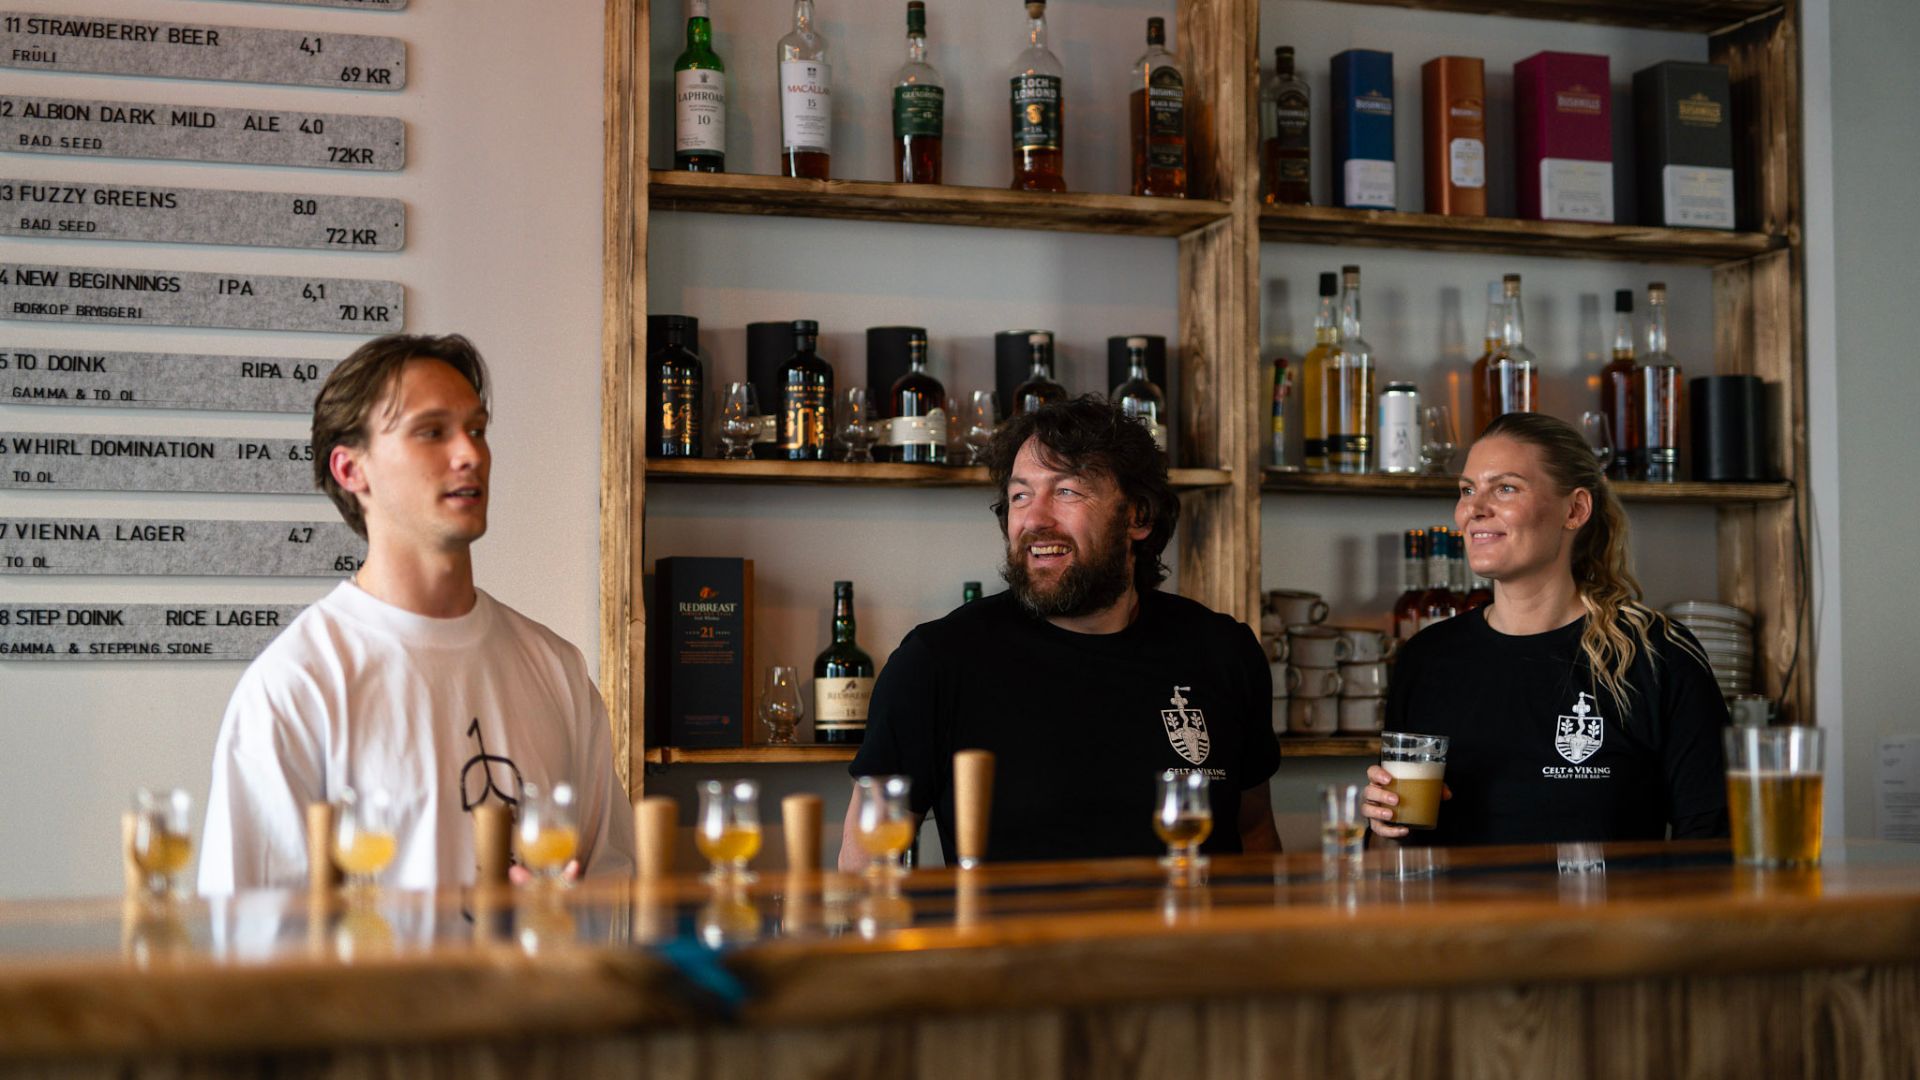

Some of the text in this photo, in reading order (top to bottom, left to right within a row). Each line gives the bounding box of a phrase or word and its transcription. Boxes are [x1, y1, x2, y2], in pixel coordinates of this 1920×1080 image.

[6, 17, 321, 56] 11 STRAWBERRY BEER 4,1
[341, 67, 390, 84] 69 KR
[1022, 78, 1049, 88] LOCH
[1014, 88, 1057, 99] LOMOND
[807, 99, 816, 107] 15
[23, 103, 89, 121] ALBION
[101, 107, 155, 124] DARK
[172, 111, 215, 128] MILD
[244, 116, 279, 132] ALE
[697, 115, 711, 125] 10
[20, 135, 102, 149] BAD SEED
[20, 186, 86, 203] FUZZY
[95, 190, 176, 208] GREENS
[294, 200, 316, 215] 8.0
[21, 219, 95, 232] BAD SEED
[327, 228, 376, 244] 72 KR
[16, 270, 58, 286] NEW
[69, 272, 180, 292] BEGINNINGS
[219, 280, 253, 295] IPA
[303, 284, 324, 302] 6,1
[14, 303, 141, 318] BORKOP BRYGGERI
[340, 305, 388, 321] 70 KR
[15, 354, 36, 370] TO
[48, 355, 105, 372] DOINK
[242, 363, 282, 378] RIPA
[13, 387, 67, 399] GAMMA
[76, 389, 85, 399] &
[94, 390, 110, 400] TO
[13, 439, 81, 455] WHIRL
[91, 440, 213, 458] DOMINATION
[239, 444, 271, 459] IPA
[14, 471, 30, 482] TO
[16, 524, 100, 540] VIENNA
[117, 526, 184, 541] LAGER
[7, 557, 23, 567] TO
[679, 602, 736, 613] REDBREAST
[16, 610, 60, 625] STEP
[68, 610, 123, 625] DOINK
[167, 611, 206, 626] RICE
[216, 611, 278, 626] LAGER
[701, 626, 714, 638] 21
[0, 643, 213, 654] GAMMA & STEPPING STONE
[1543, 766, 1567, 774] CELT
[1574, 766, 1611, 774] VIKING
